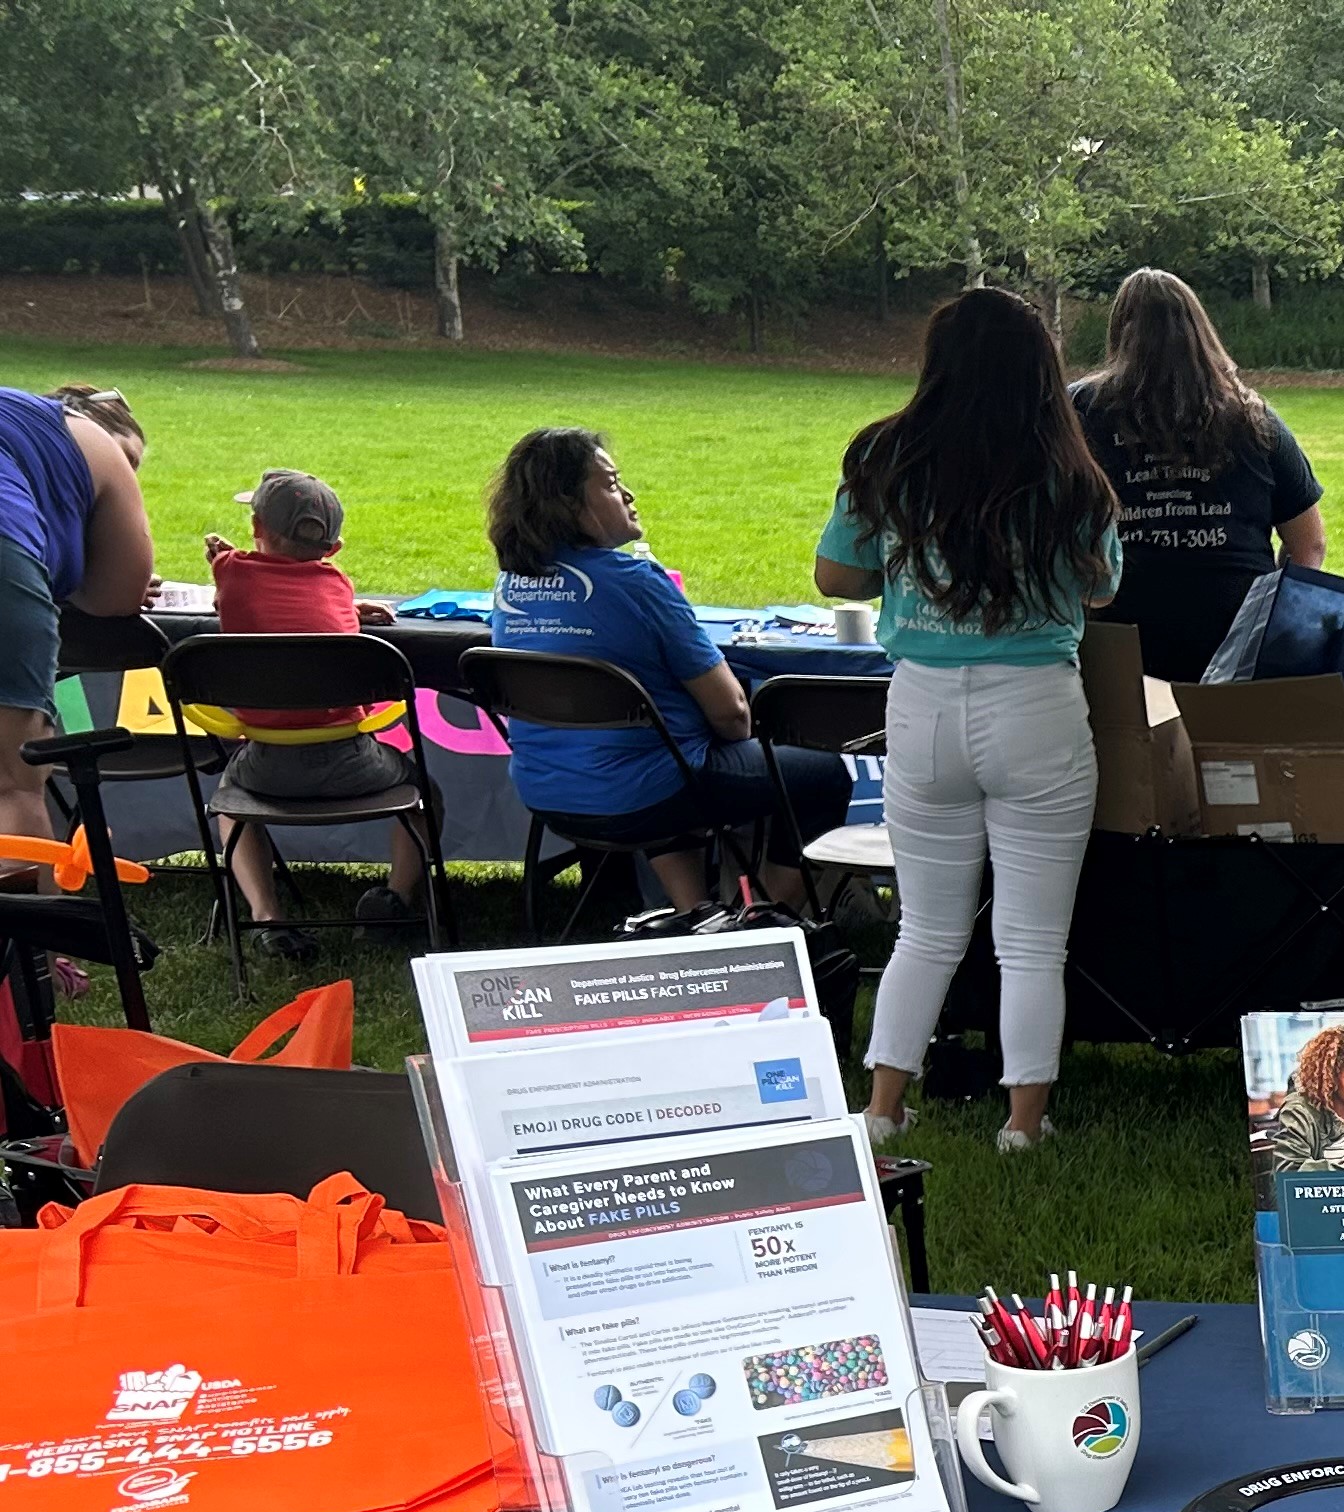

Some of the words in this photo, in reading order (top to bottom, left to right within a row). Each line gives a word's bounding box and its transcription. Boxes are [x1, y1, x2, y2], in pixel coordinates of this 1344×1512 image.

[1200, 501, 1231, 516] Lead
[508, 590, 576, 602] Department
[481, 976, 520, 992] ONE
[575, 990, 610, 1006] FAKE
[612, 987, 648, 1003] PILLS
[650, 984, 684, 998] FACT
[686, 979, 729, 995] SHEET
[511, 987, 552, 1004] CAN
[503, 1003, 543, 1020] KILL
[513, 1121, 558, 1135] EMOJI
[562, 1116, 602, 1131] DRUG
[606, 1111, 644, 1125] CODE
[656, 1102, 721, 1120] DECODED
[524, 1182, 568, 1201] What
[574, 1176, 618, 1195] Every
[623, 1168, 678, 1188] Parent
[681, 1163, 711, 1178] and
[529, 1195, 610, 1218] Caregiver
[614, 1186, 666, 1204] Needs
[670, 1184, 686, 1197] to
[691, 1177, 735, 1193] Know
[1322, 1205, 1329, 1213] A
[533, 1215, 585, 1235] About
[588, 1208, 631, 1226] FAKE
[636, 1201, 681, 1218] PILLS
[782, 1252, 817, 1264] POTENT
[757, 1269, 781, 1280] THAN
[26, 1436, 147, 1460] NEBRASKA
[155, 1429, 217, 1444] SNAP
[221, 1421, 317, 1437] HOTLINE
[1238, 1478, 1282, 1497] DRUG
